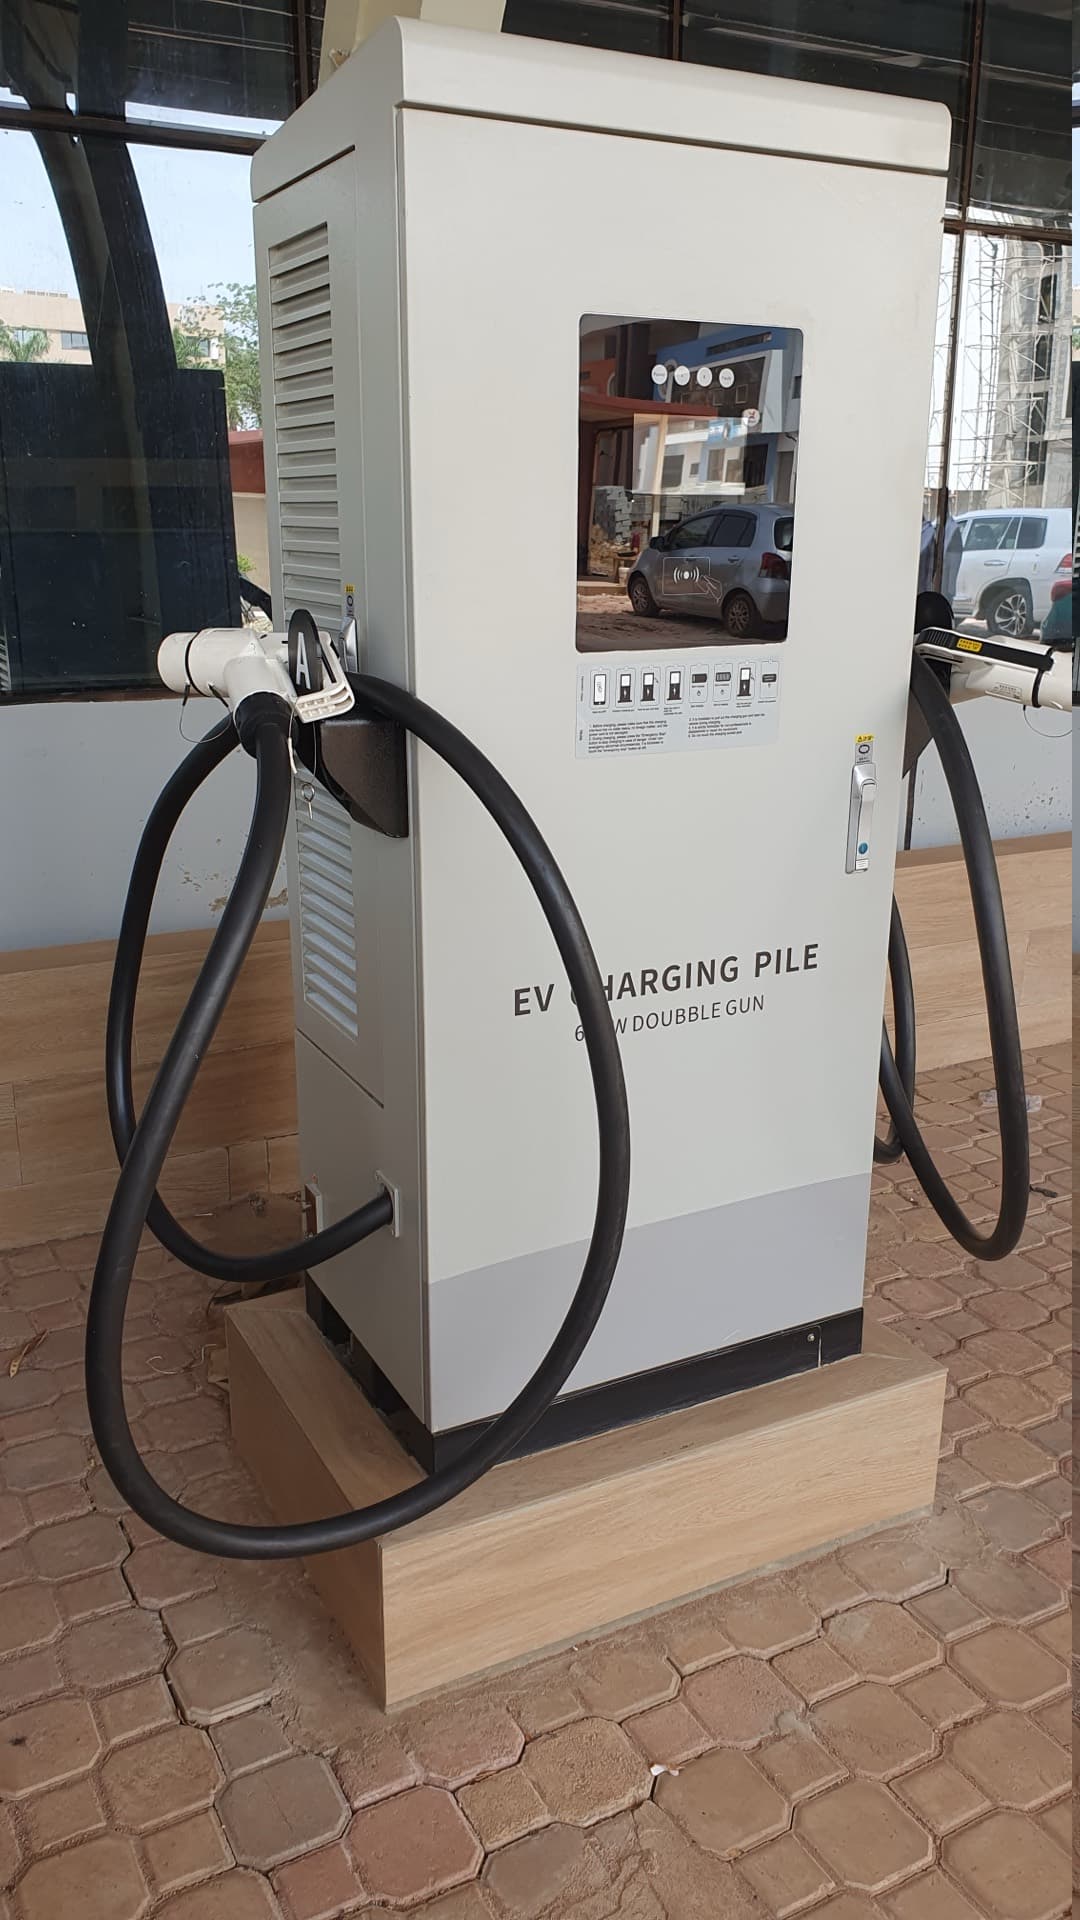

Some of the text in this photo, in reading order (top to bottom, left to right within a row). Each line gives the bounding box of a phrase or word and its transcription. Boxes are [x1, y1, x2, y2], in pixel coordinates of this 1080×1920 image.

[296, 631, 311, 690] A
[514, 943, 819, 1016] EV HARGING PILE
[575, 994, 764, 1042] 6W DOUBBLE GUN
